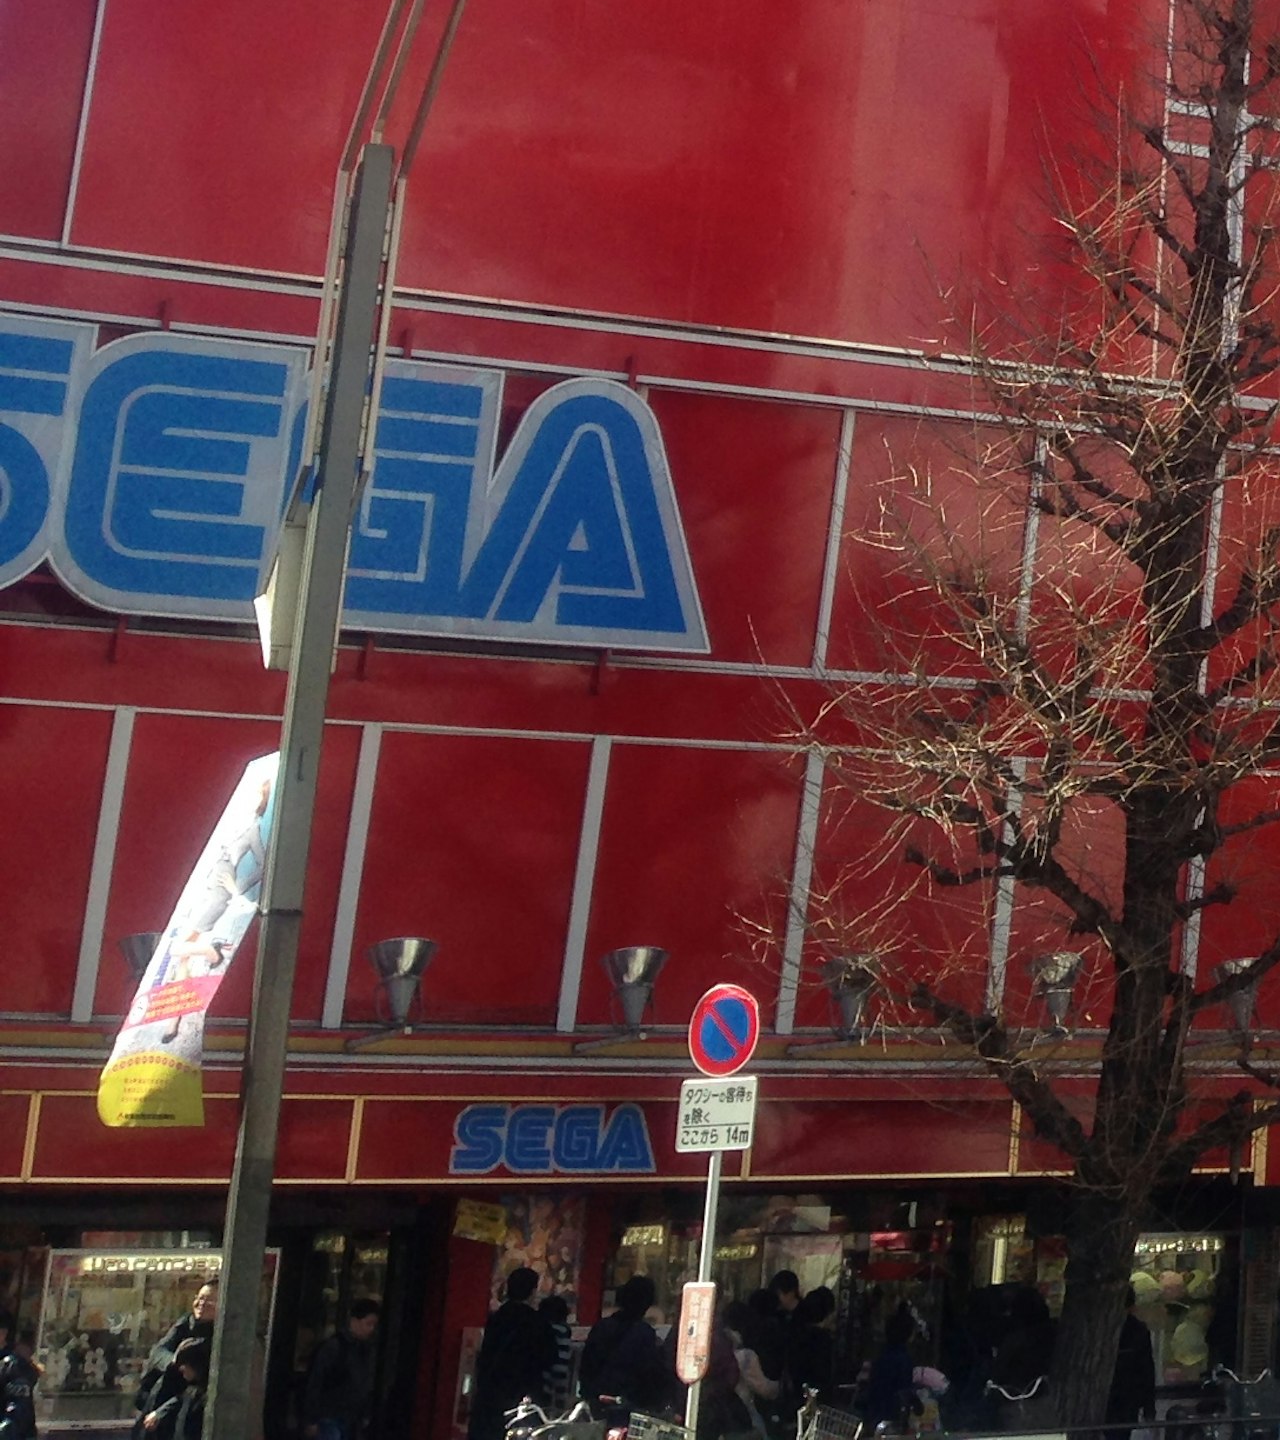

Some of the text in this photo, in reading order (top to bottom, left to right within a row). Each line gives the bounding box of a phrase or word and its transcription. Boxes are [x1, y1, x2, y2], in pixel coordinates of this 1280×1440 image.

[450, 1101, 657, 1175] SEGA
[681, 1126, 750, 1146] ここから 14m
